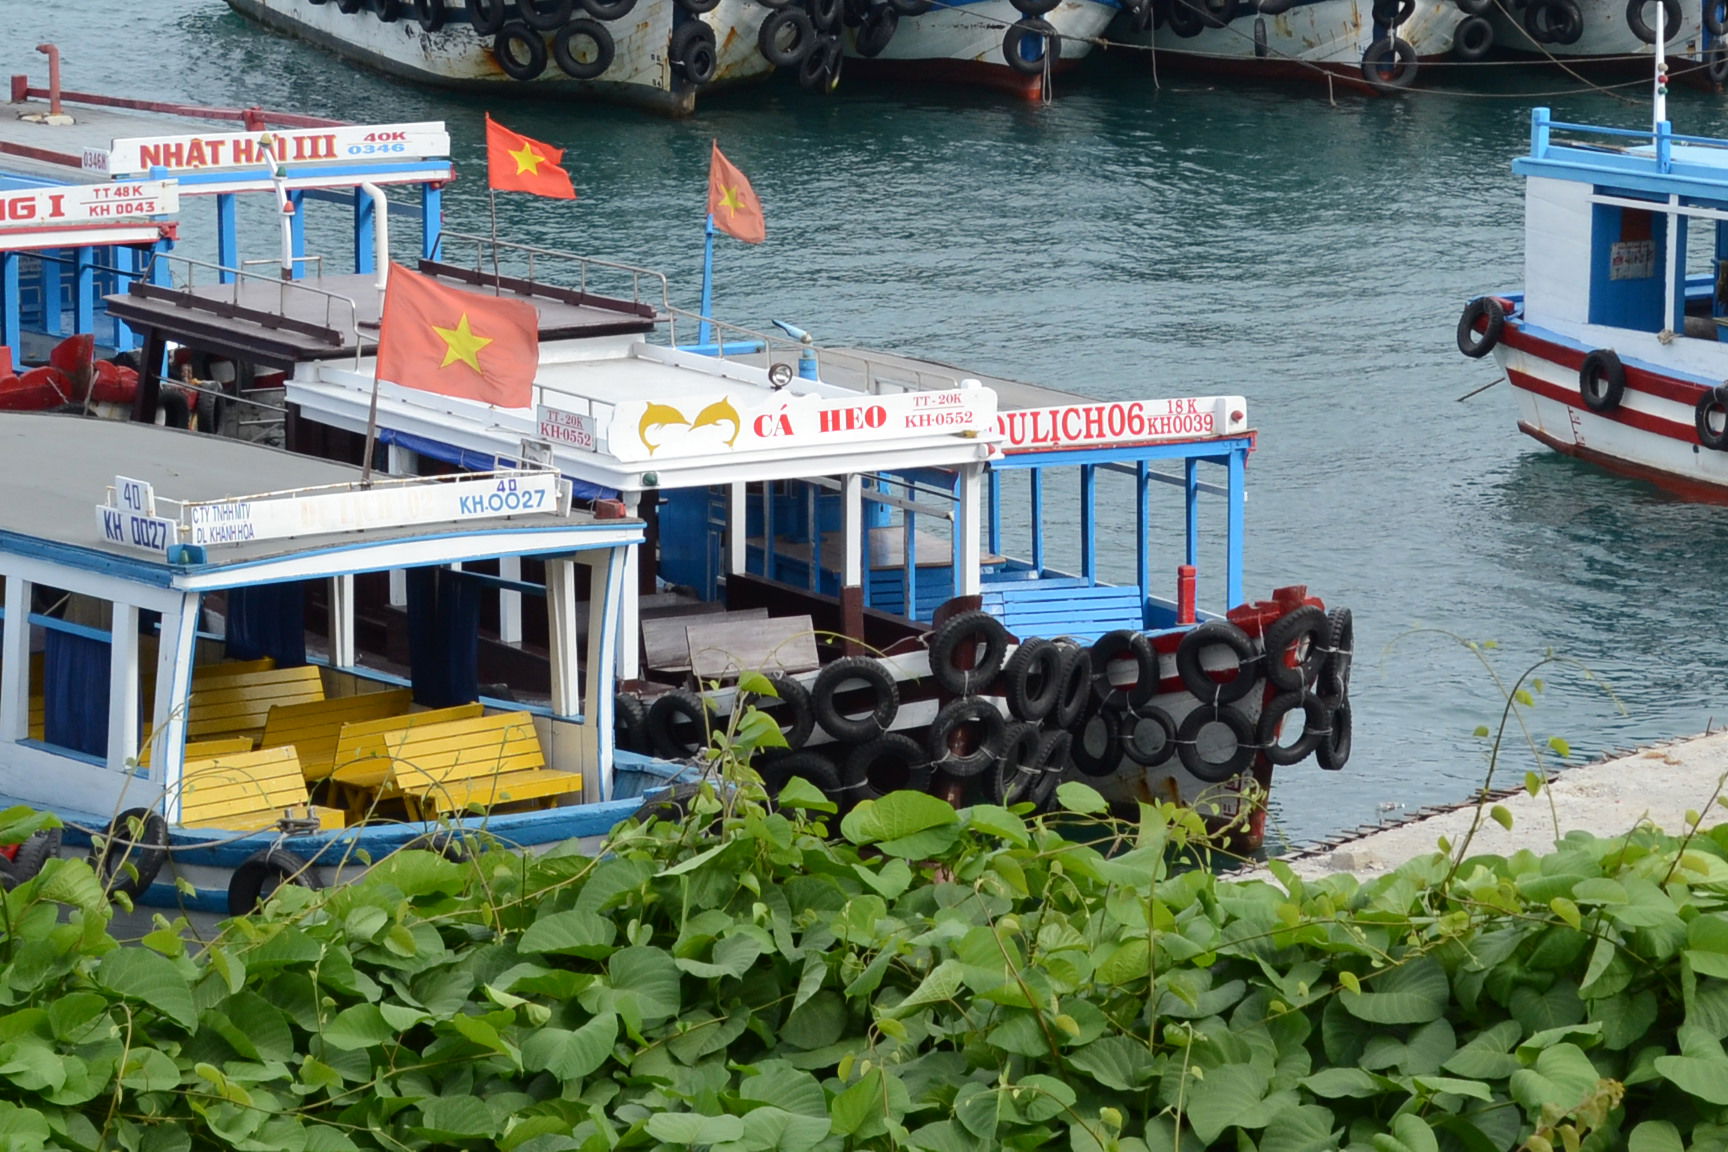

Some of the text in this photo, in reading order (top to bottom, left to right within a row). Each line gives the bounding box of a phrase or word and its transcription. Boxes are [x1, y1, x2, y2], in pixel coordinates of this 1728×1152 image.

[292, 133, 338, 161] III
[347, 143, 406, 155] 0346
[363, 131, 408, 142] 40K
[753, 404, 887, 438] CÁ HEO
[124, 482, 141, 510] 40
[497, 479, 517, 493] 40
[104, 510, 167, 550] KH 0027
